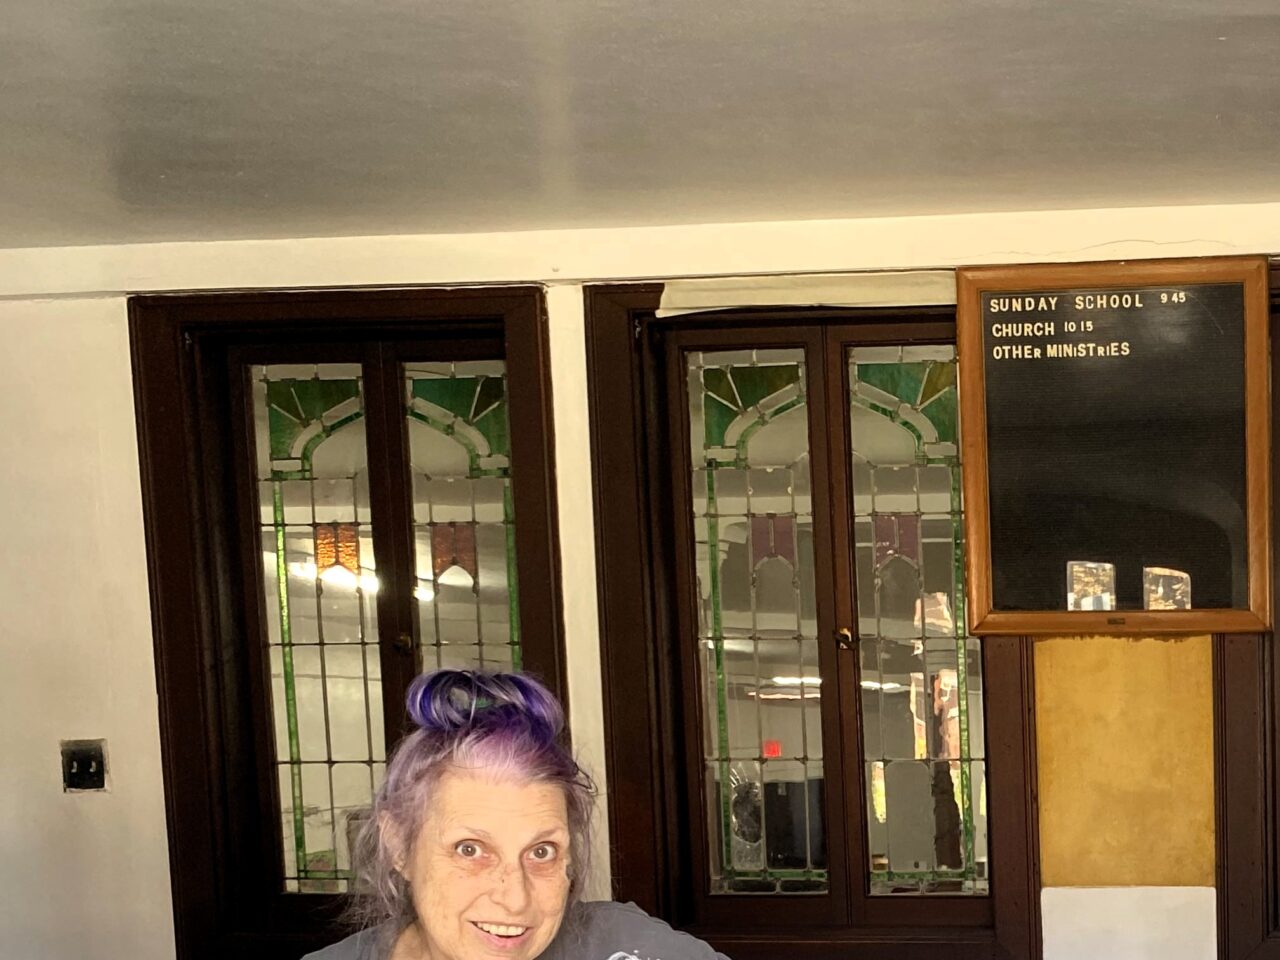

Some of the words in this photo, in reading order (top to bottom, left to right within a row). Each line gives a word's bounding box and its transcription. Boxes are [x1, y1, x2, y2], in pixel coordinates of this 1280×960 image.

[990, 297, 1057, 312] SUNDAY
[1075, 294, 1143, 309] SCHOOL
[992, 322, 1055, 337] CHURCH
